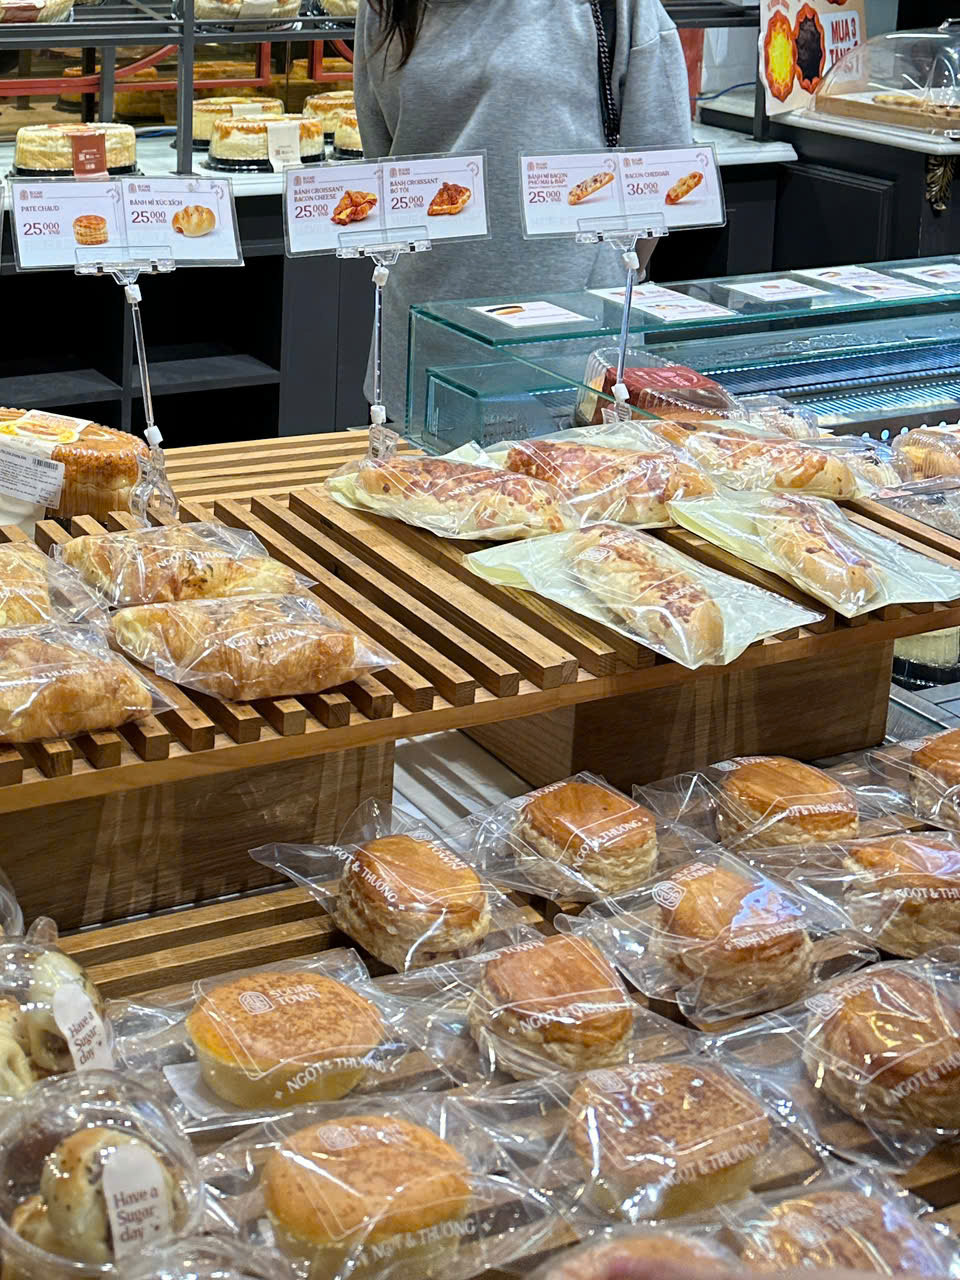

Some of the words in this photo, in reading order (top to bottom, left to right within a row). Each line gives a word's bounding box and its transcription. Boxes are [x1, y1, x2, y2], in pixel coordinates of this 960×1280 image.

[131, 210, 166, 224] 25.000
[23, 222, 60, 236] 25.000
[68, 1020, 89, 1039] Have
[73, 1024, 97, 1053] Sugar
[79, 1047, 96, 1066] day
[113, 1190, 147, 1209] Have
[117, 1206, 156, 1227] Sugar
[120, 1225, 145, 1245] day
